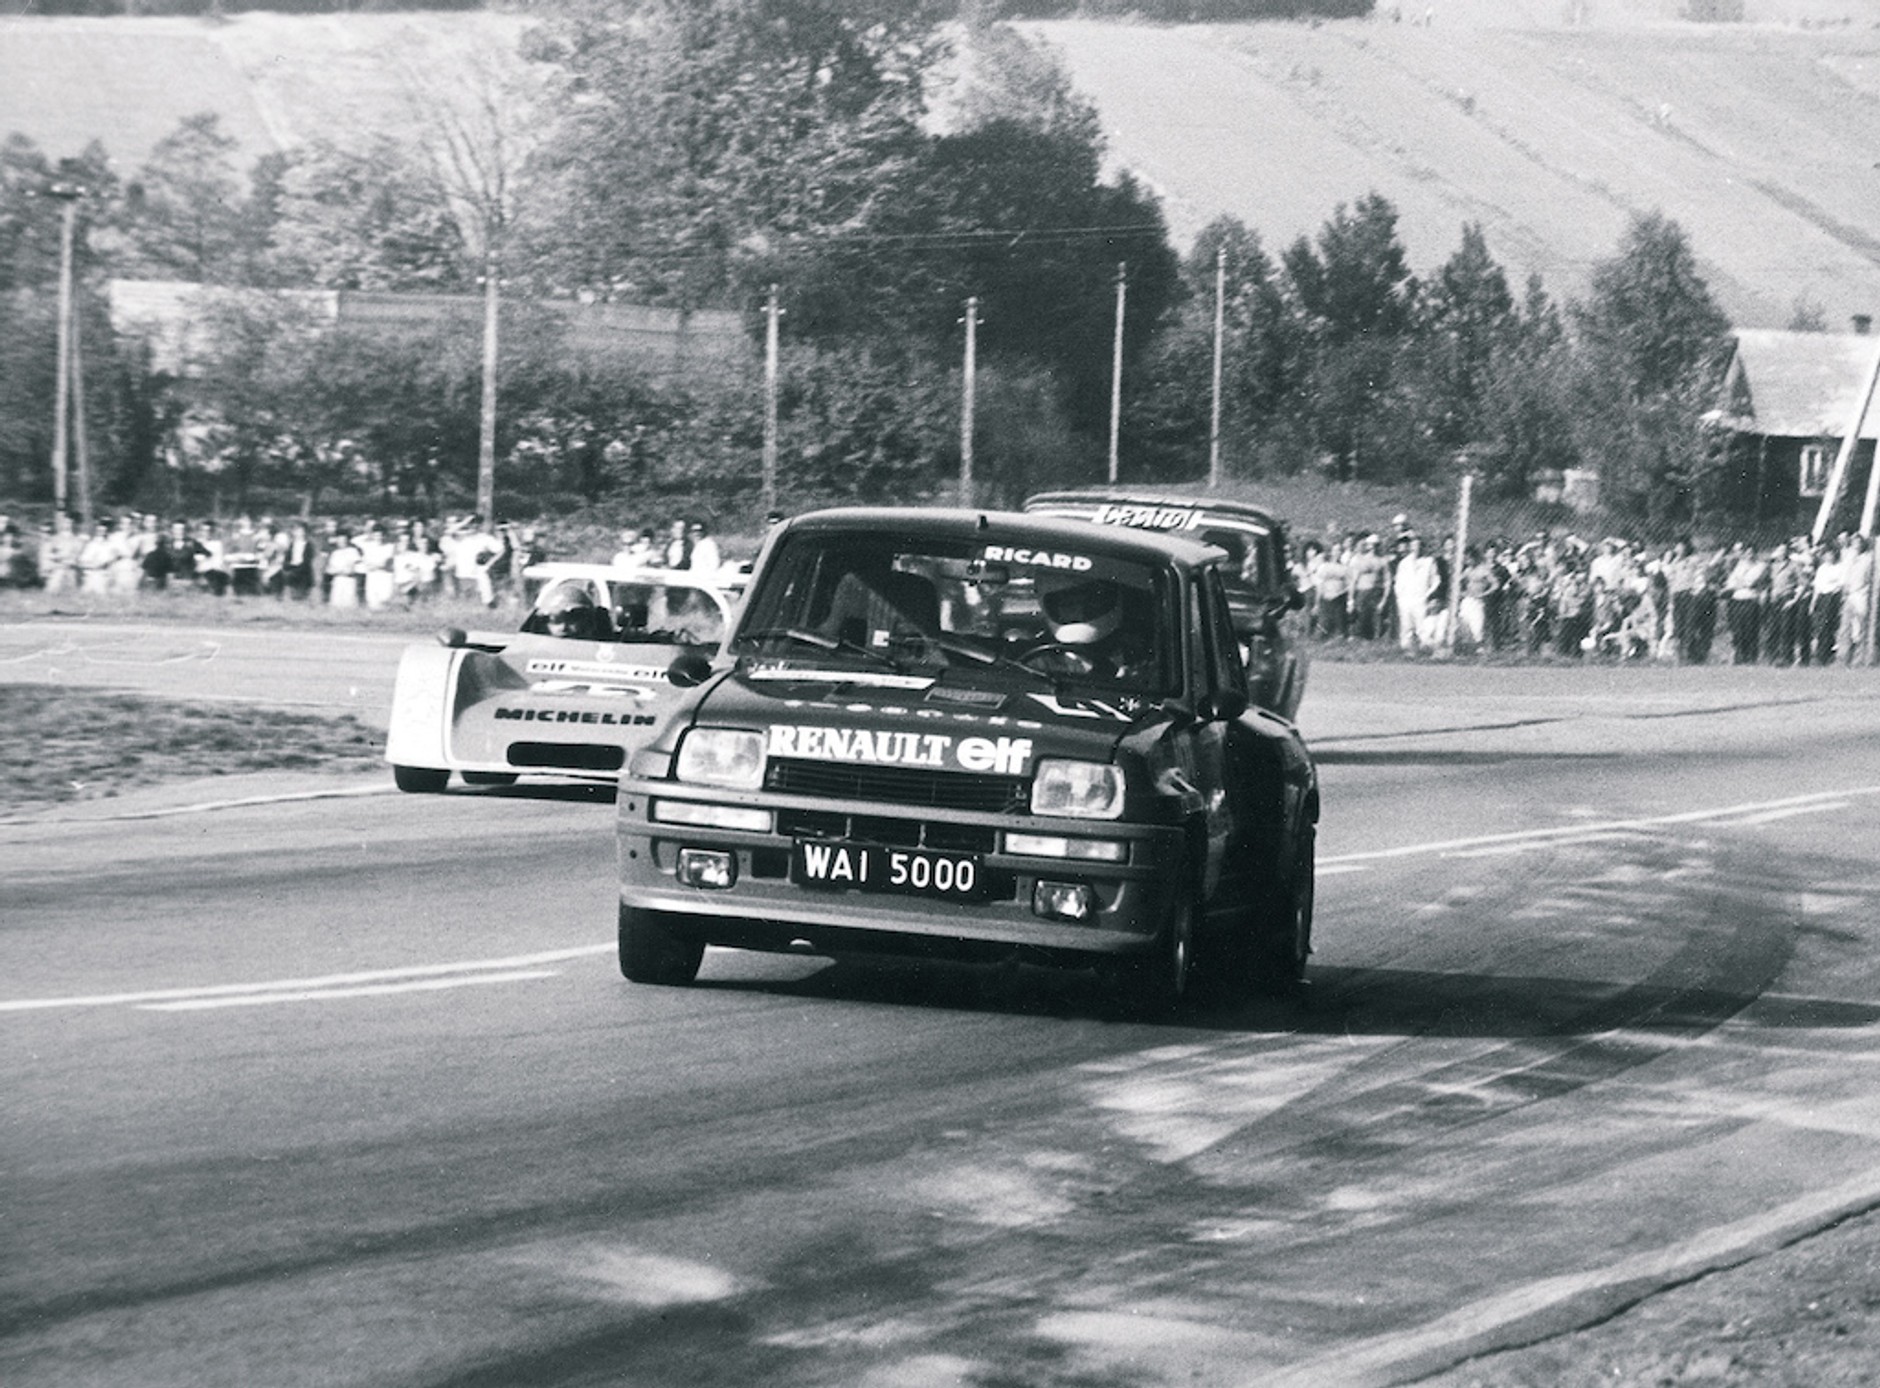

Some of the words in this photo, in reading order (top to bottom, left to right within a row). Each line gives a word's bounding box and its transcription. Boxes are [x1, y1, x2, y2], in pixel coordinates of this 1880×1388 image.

[984, 546, 1093, 571] RICARD
[531, 662, 567, 672] elf
[494, 708, 656, 726] MICHELIN
[766, 725, 952, 766] RENAULT
[956, 735, 1033, 774] elf
[804, 844, 868, 882] WAI
[890, 853, 975, 892] 5000
